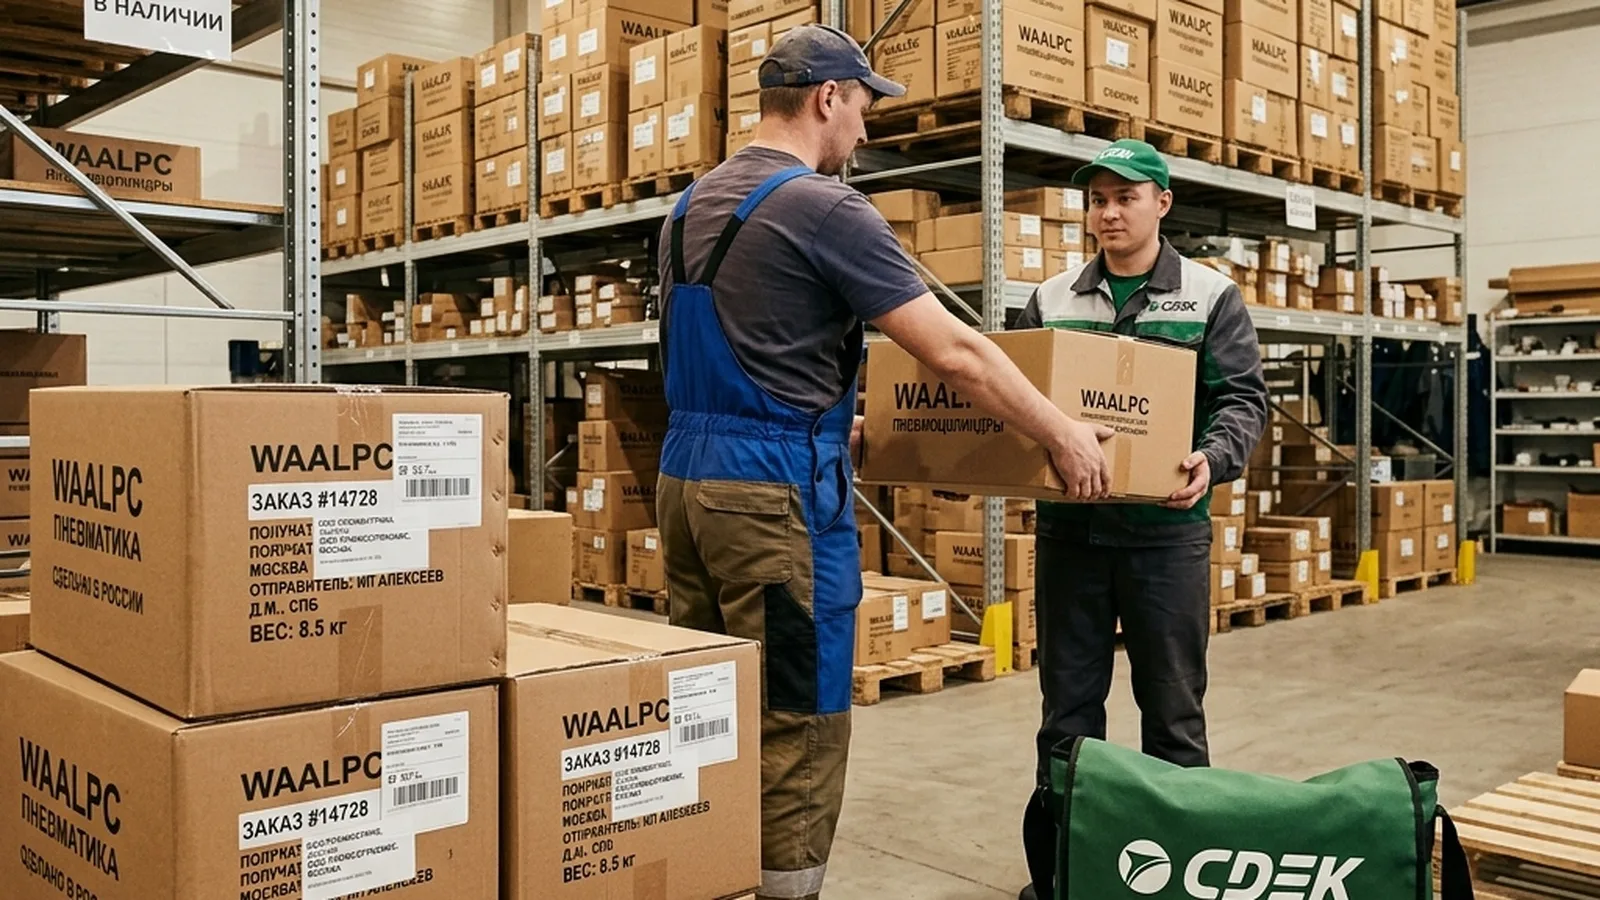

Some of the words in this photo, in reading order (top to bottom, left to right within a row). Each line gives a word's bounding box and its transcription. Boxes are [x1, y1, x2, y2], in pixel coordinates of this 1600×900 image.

[115, 0, 223, 31] НАЛИЧИИ
[1018, 24, 1072, 53] WAALPC
[1081, 388, 1150, 415] WAALPC
[251, 443, 393, 473] WAALPC
[52, 459, 144, 518] WAALPC
[252, 491, 313, 511] ЗАКАЗ
[317, 489, 379, 508] #14728
[250, 621, 293, 643] ВЕС:
[299, 619, 325, 638] 8.5
[562, 698, 670, 740] WAALPC
[564, 749, 611, 772] ЗАКАЗ
[20, 736, 121, 835] WAALPC
[240, 751, 382, 801] WAALPC
[22, 792, 119, 882] ПНЕВМАТИКА
[243, 812, 303, 840] ЗАКАЗ
[563, 862, 597, 883] ВЕС:
[599, 857, 620, 874] 8.5
[1183, 848, 1366, 900] CDEK
